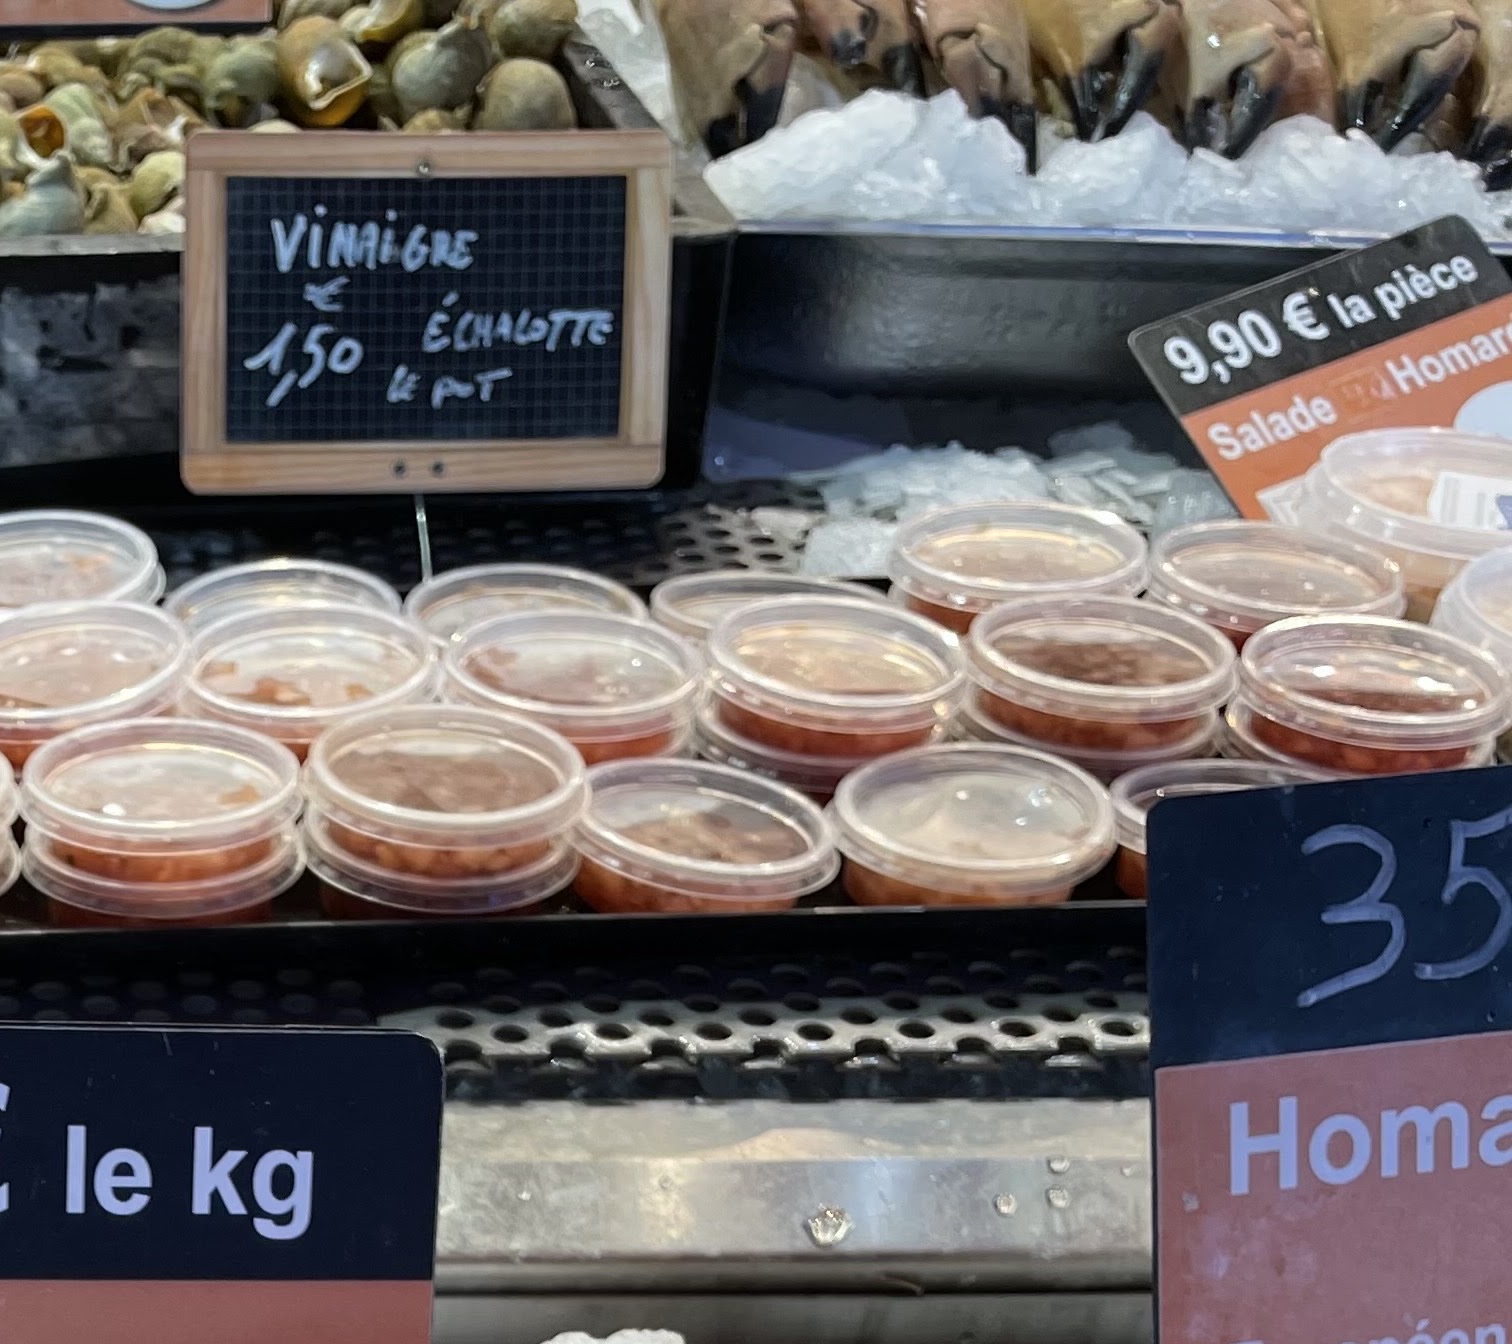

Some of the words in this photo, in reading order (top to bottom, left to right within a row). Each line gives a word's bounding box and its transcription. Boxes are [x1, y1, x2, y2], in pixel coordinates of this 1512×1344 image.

[243, 321, 364, 408] 1,50
[1163, 310, 1283, 386] 9,90
[1282, 290, 1330, 341] €
[1326, 292, 1376, 329] la
[1373, 252, 1479, 322] pièce
[1207, 392, 1337, 461] Salade
[1384, 312, 1512, 395] Homar
[65, 1126, 153, 1215] le
[191, 1126, 314, 1240] kg
